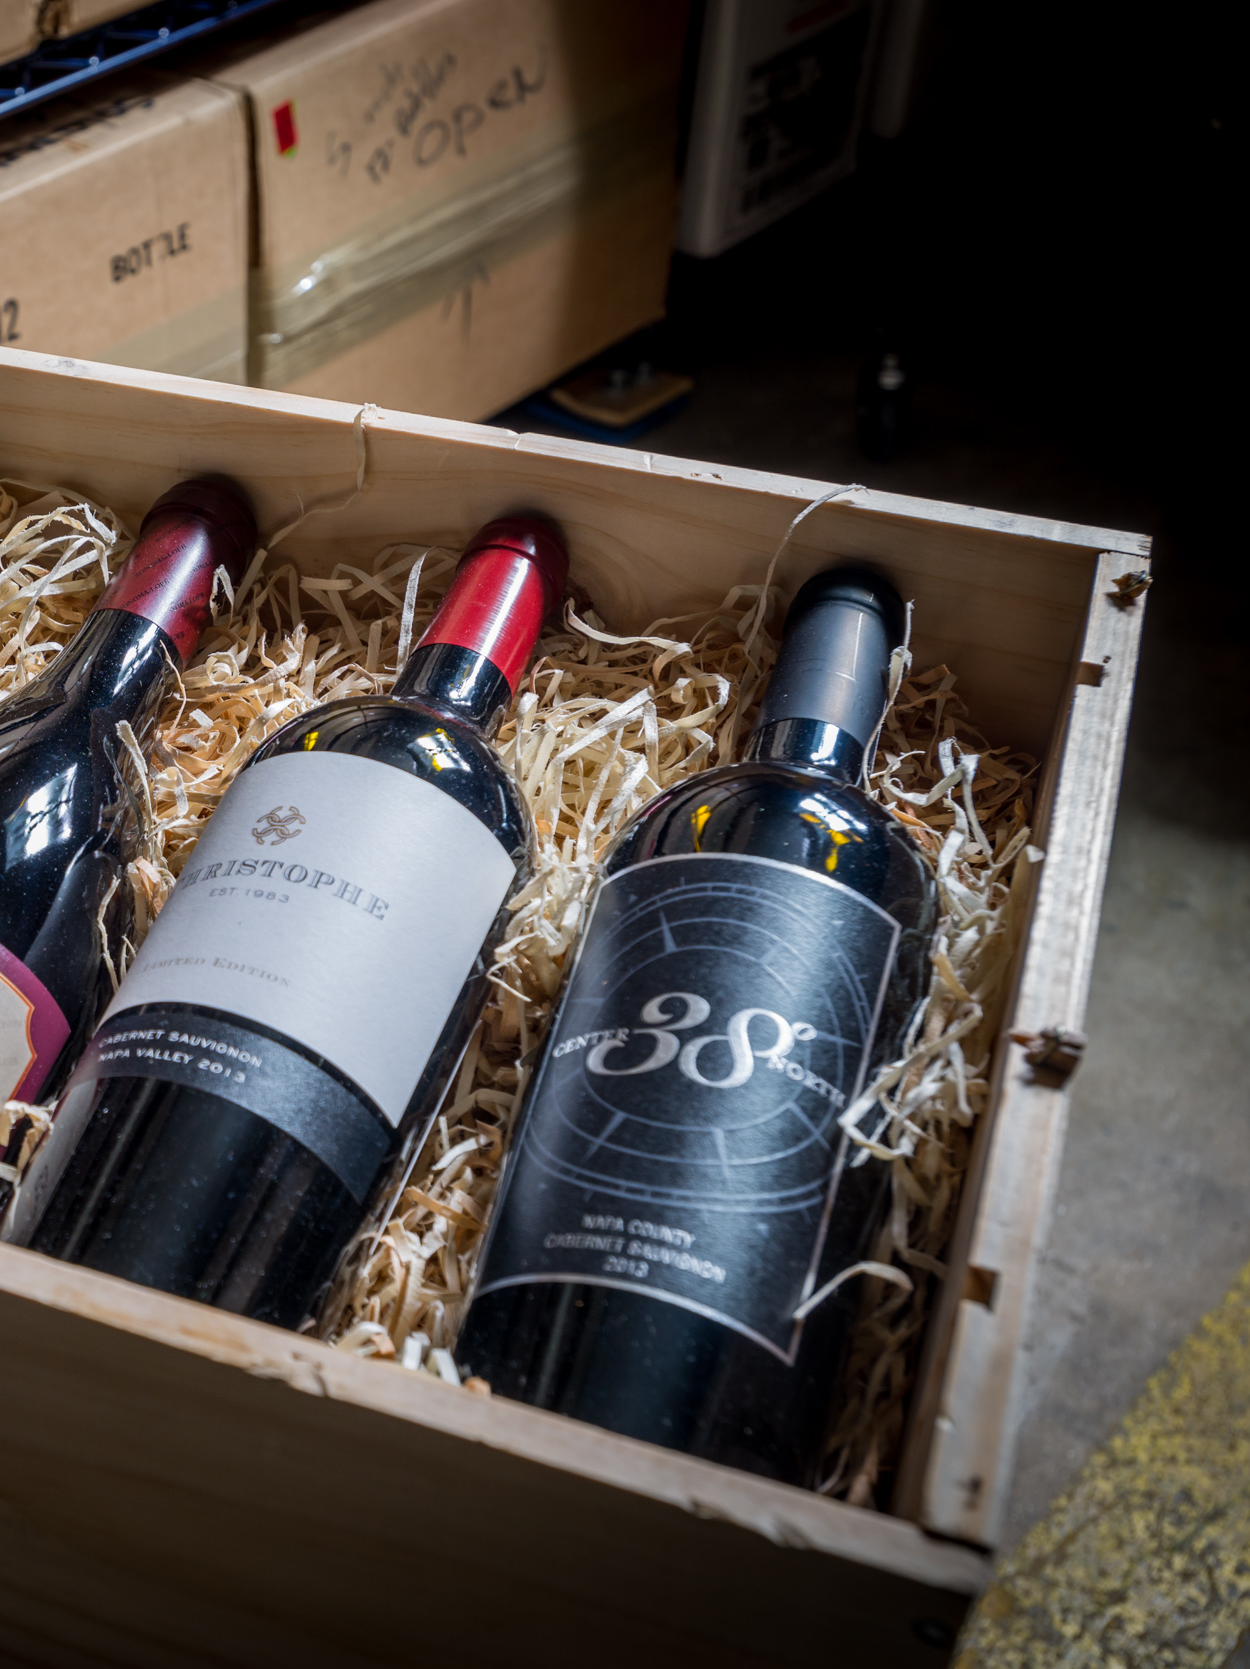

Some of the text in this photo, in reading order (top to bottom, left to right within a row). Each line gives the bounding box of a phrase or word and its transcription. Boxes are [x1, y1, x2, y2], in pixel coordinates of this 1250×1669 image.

[209, 887, 291, 904] EST. 1983
[142, 956, 292, 988] LIMITED EDITION
[97, 1029, 263, 1068] CABERNET SAUVIGNON
[552, 1026, 630, 1058] CENTER
[97, 1047, 247, 1084] NAPA VALLEY 2013
[581, 1213, 625, 1233] NAPA
[543, 1231, 626, 1253] CABERNET
